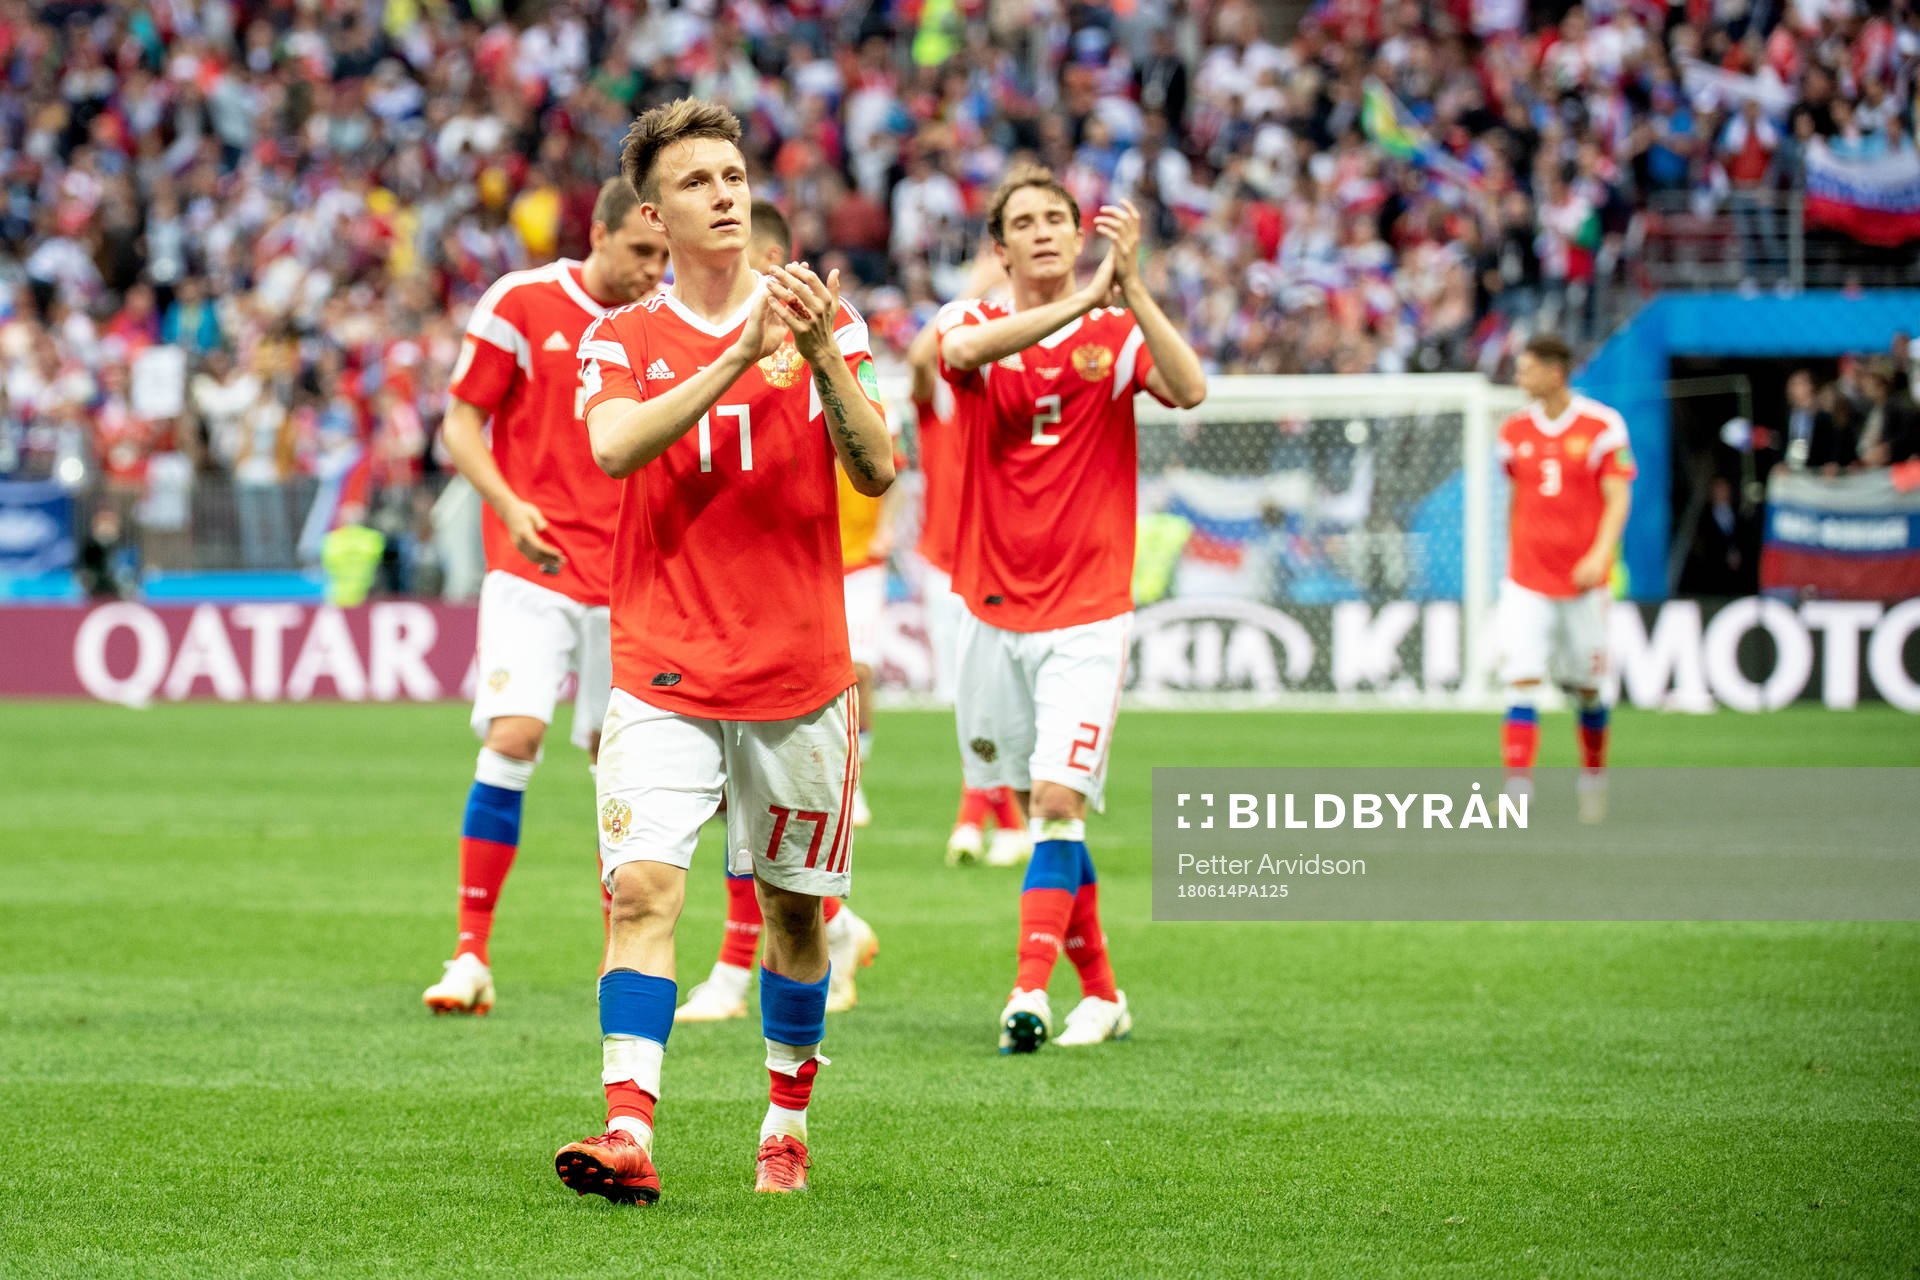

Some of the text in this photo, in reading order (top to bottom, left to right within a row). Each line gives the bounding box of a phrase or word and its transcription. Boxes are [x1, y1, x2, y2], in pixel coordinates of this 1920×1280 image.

[697, 403, 753, 473] 17
[1031, 394, 1062, 446] 2
[1539, 457, 1562, 497] 3
[73, 601, 441, 708] QATAR
[1138, 619, 1282, 700] KIA
[1331, 599, 1500, 698] KI
[1067, 722, 1100, 772] 2
[765, 804, 828, 869] 17
